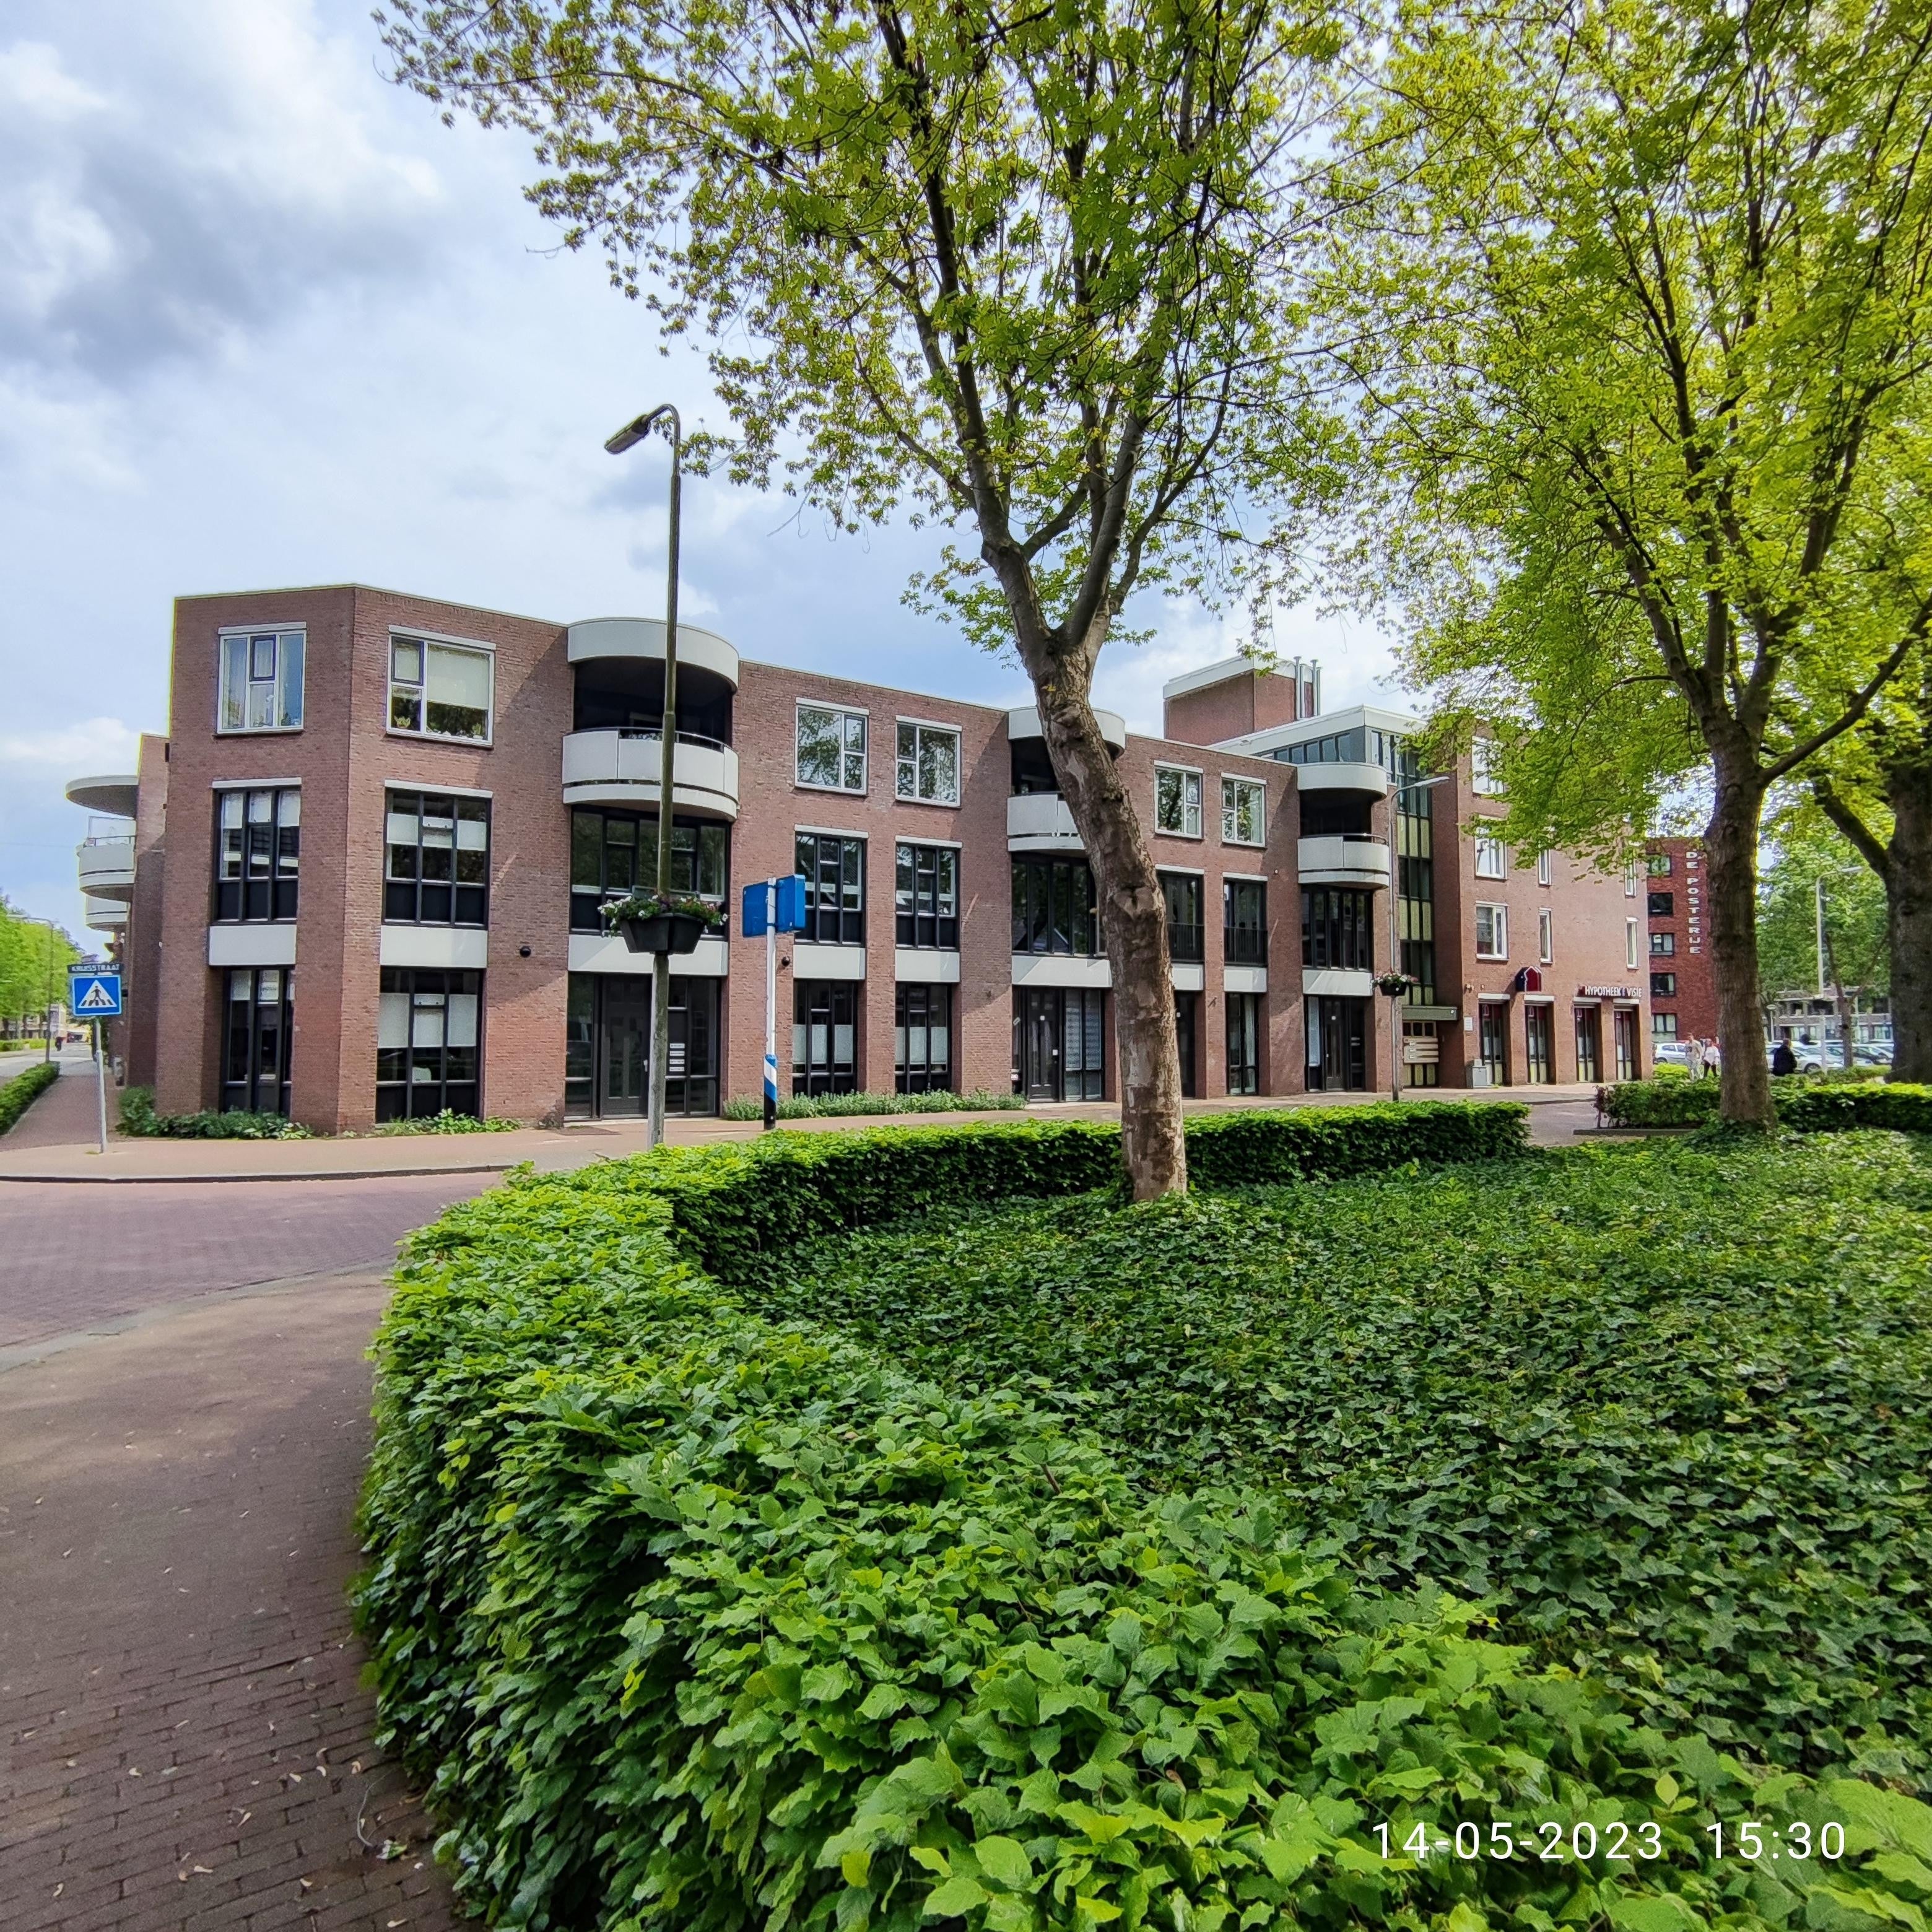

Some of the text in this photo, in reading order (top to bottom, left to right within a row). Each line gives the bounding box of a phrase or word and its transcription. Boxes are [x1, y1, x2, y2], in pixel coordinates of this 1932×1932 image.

[1686, 851, 1699, 869] DE
[1585, 985, 1642, 998] HYPOTHEEK VISIE
